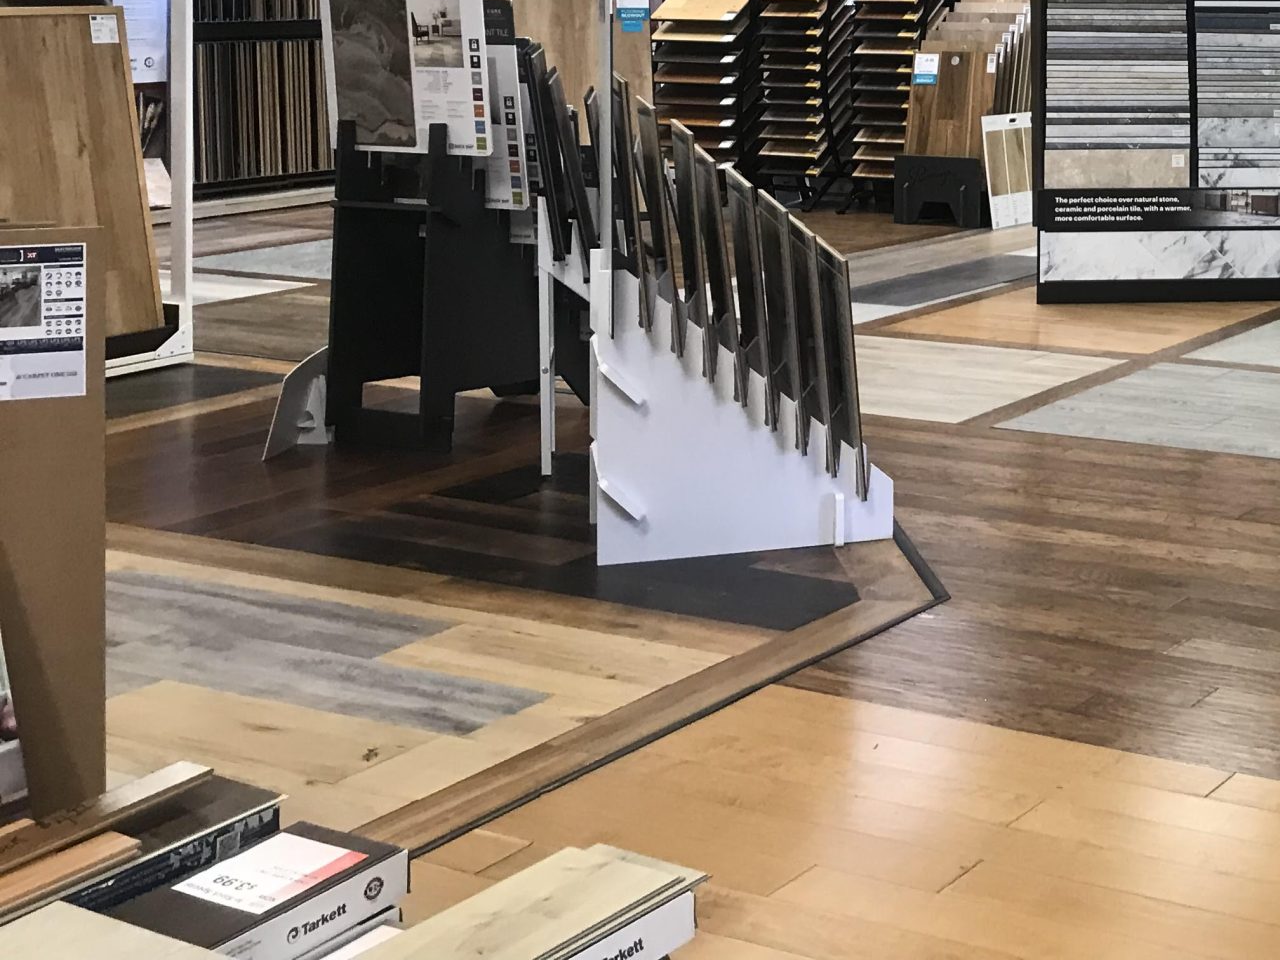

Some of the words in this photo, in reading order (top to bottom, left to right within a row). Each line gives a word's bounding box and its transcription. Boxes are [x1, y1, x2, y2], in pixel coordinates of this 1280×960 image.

[1069, 196, 1094, 205] perfect
[1097, 206, 1129, 214] porcelain
[302, 903, 347, 936] Tarkett
